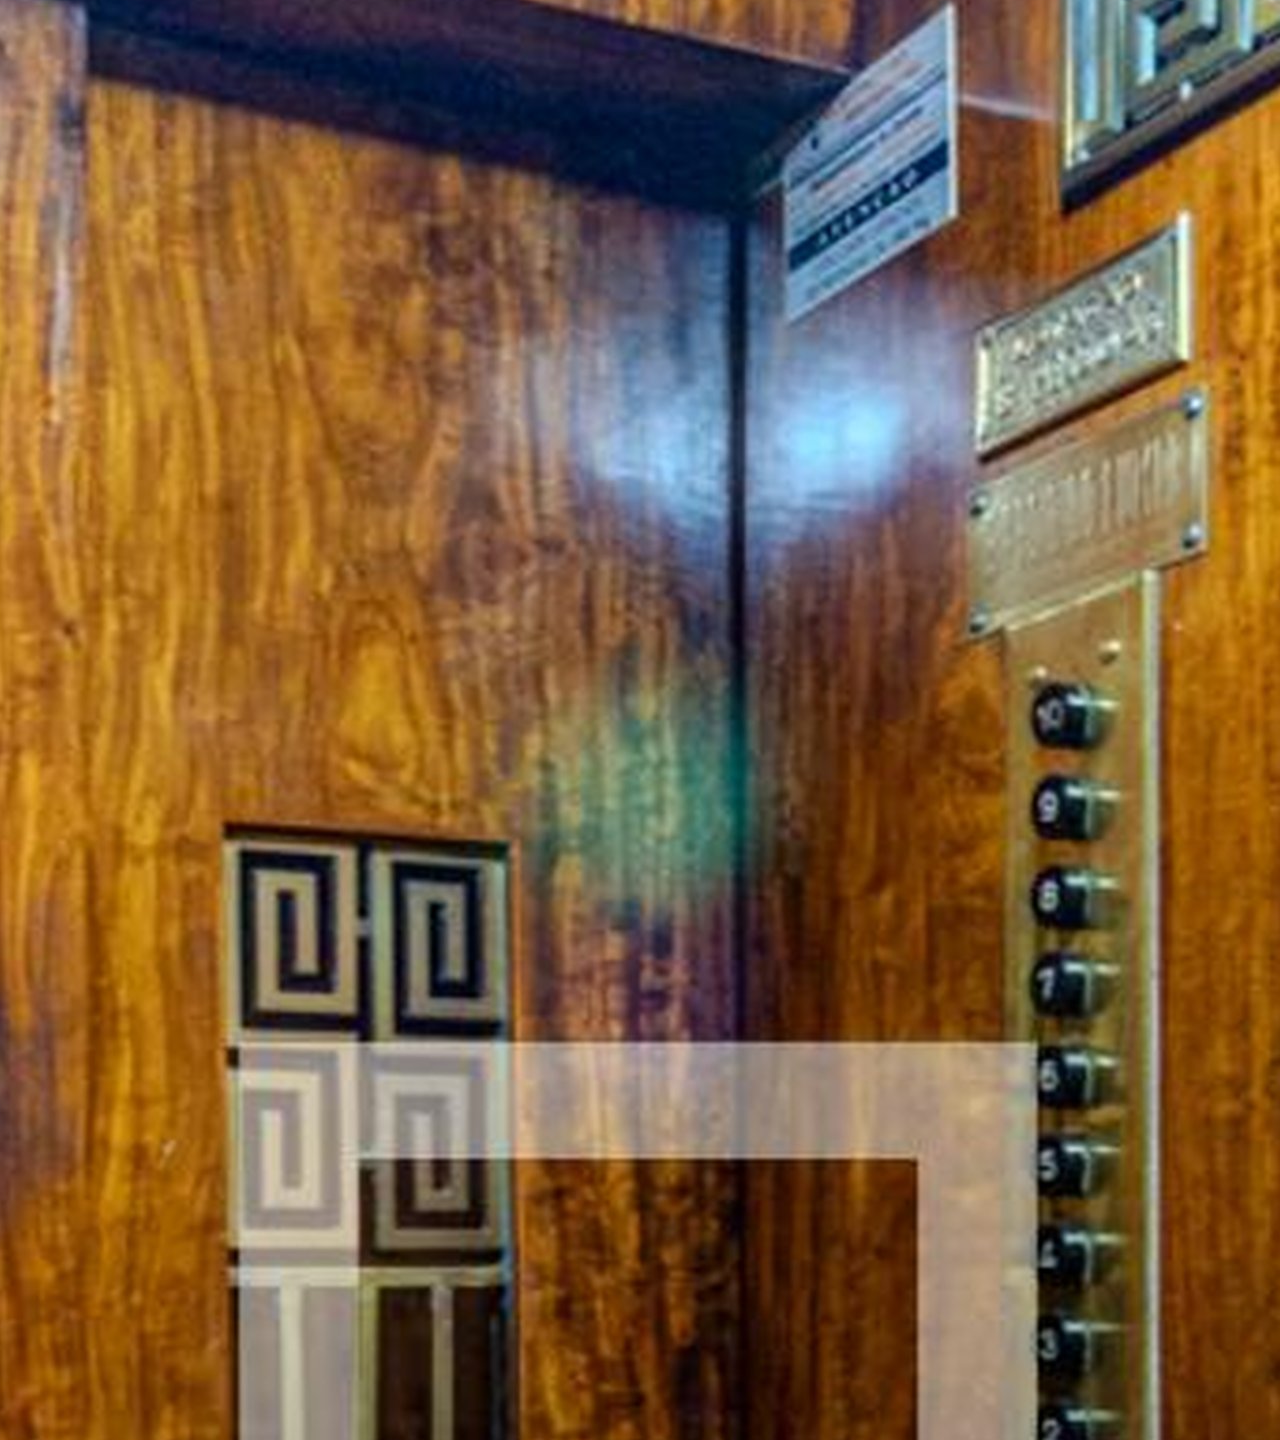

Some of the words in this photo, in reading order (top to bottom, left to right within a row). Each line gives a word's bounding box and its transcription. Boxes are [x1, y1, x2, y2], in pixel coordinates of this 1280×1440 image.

[1037, 789, 1059, 823] 9
[1038, 880, 1060, 912] 8
[1037, 966, 1056, 1001] 7
[1039, 1058, 1060, 1092] 6
[1039, 1149, 1059, 1181] 5
[1039, 1328, 1059, 1360] 3
